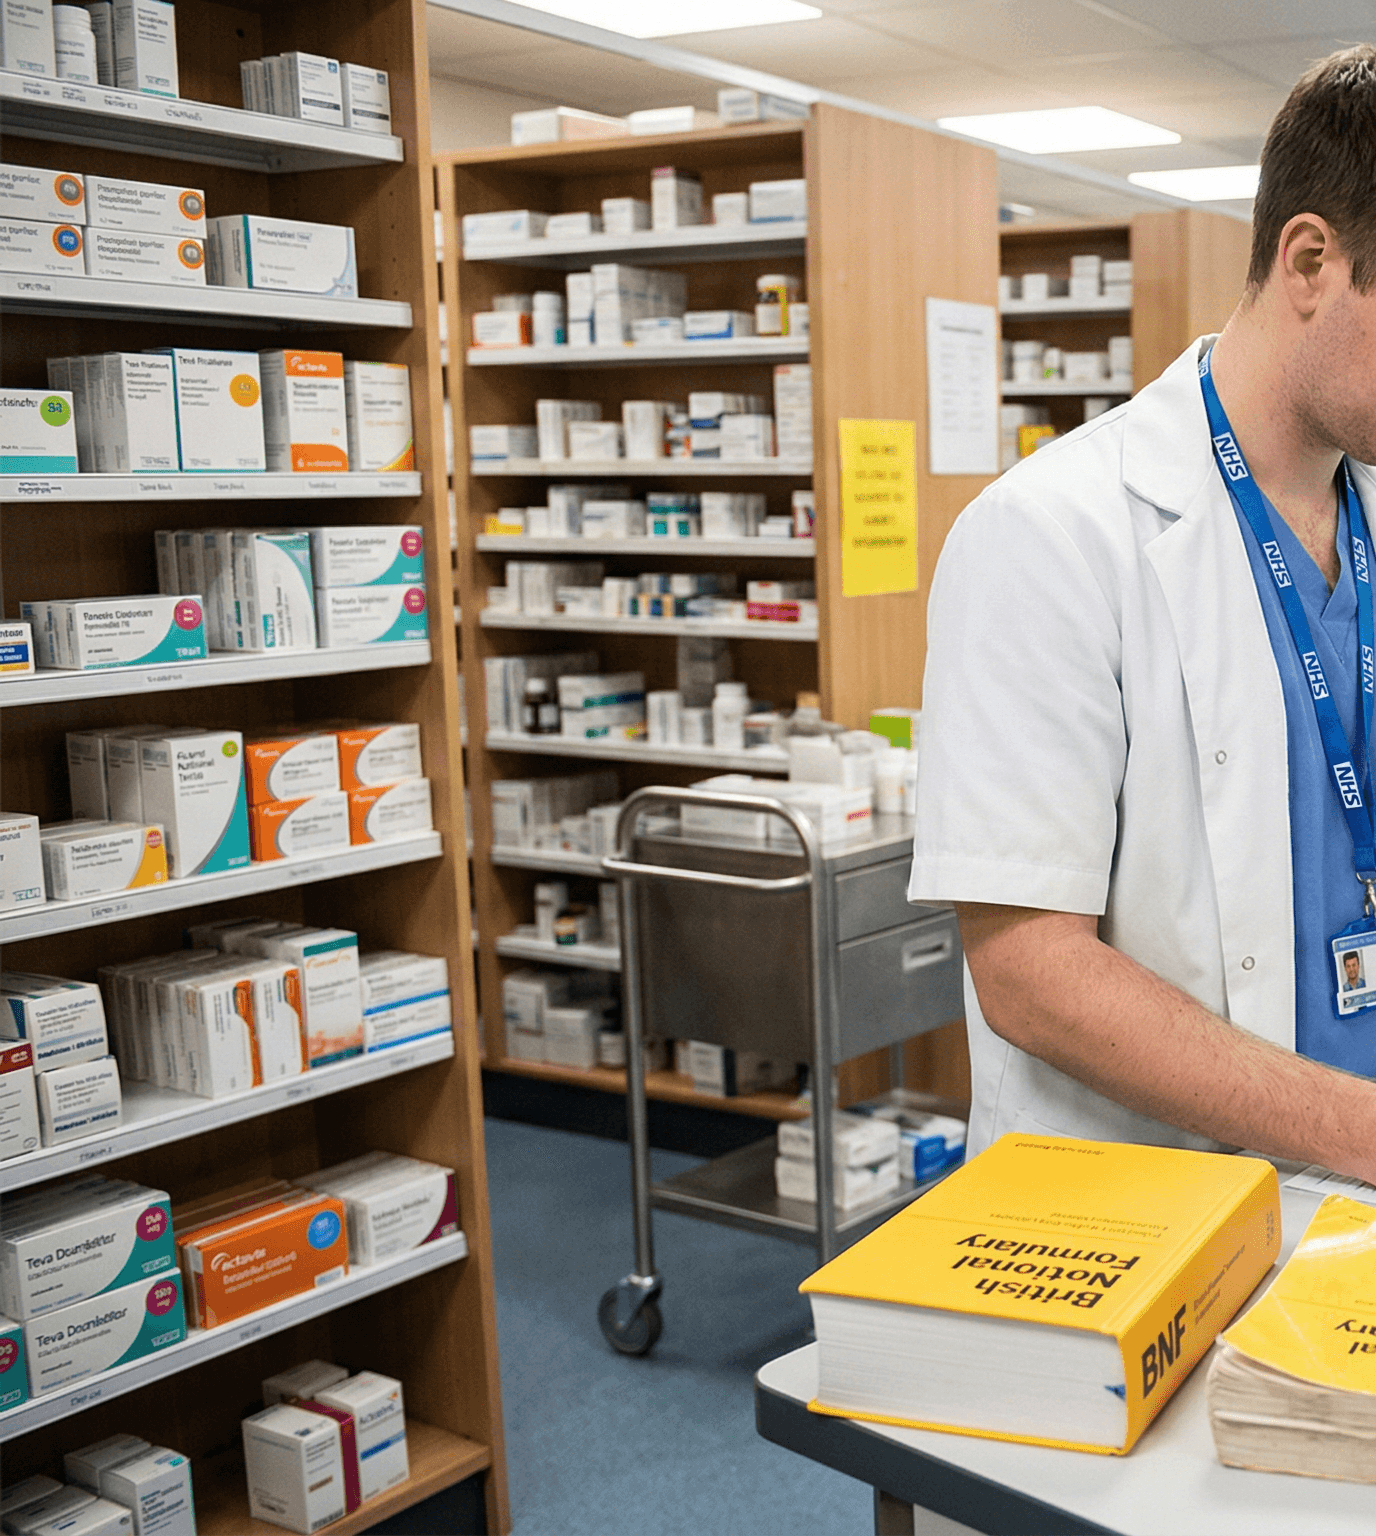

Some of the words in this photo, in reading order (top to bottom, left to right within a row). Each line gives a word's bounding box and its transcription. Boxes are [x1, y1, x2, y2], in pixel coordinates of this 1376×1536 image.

[1214, 433, 1248, 480] NHS
[1263, 542, 1291, 587] NHS
[1303, 653, 1329, 698] NHS
[1334, 763, 1362, 808] NHS
[25, 1253, 54, 1270] Teva
[954, 1233, 1142, 1271] Formulary
[974, 1277, 1104, 1309] British
[35, 1331, 65, 1347] Teva
[1140, 1303, 1187, 1398] BNF
